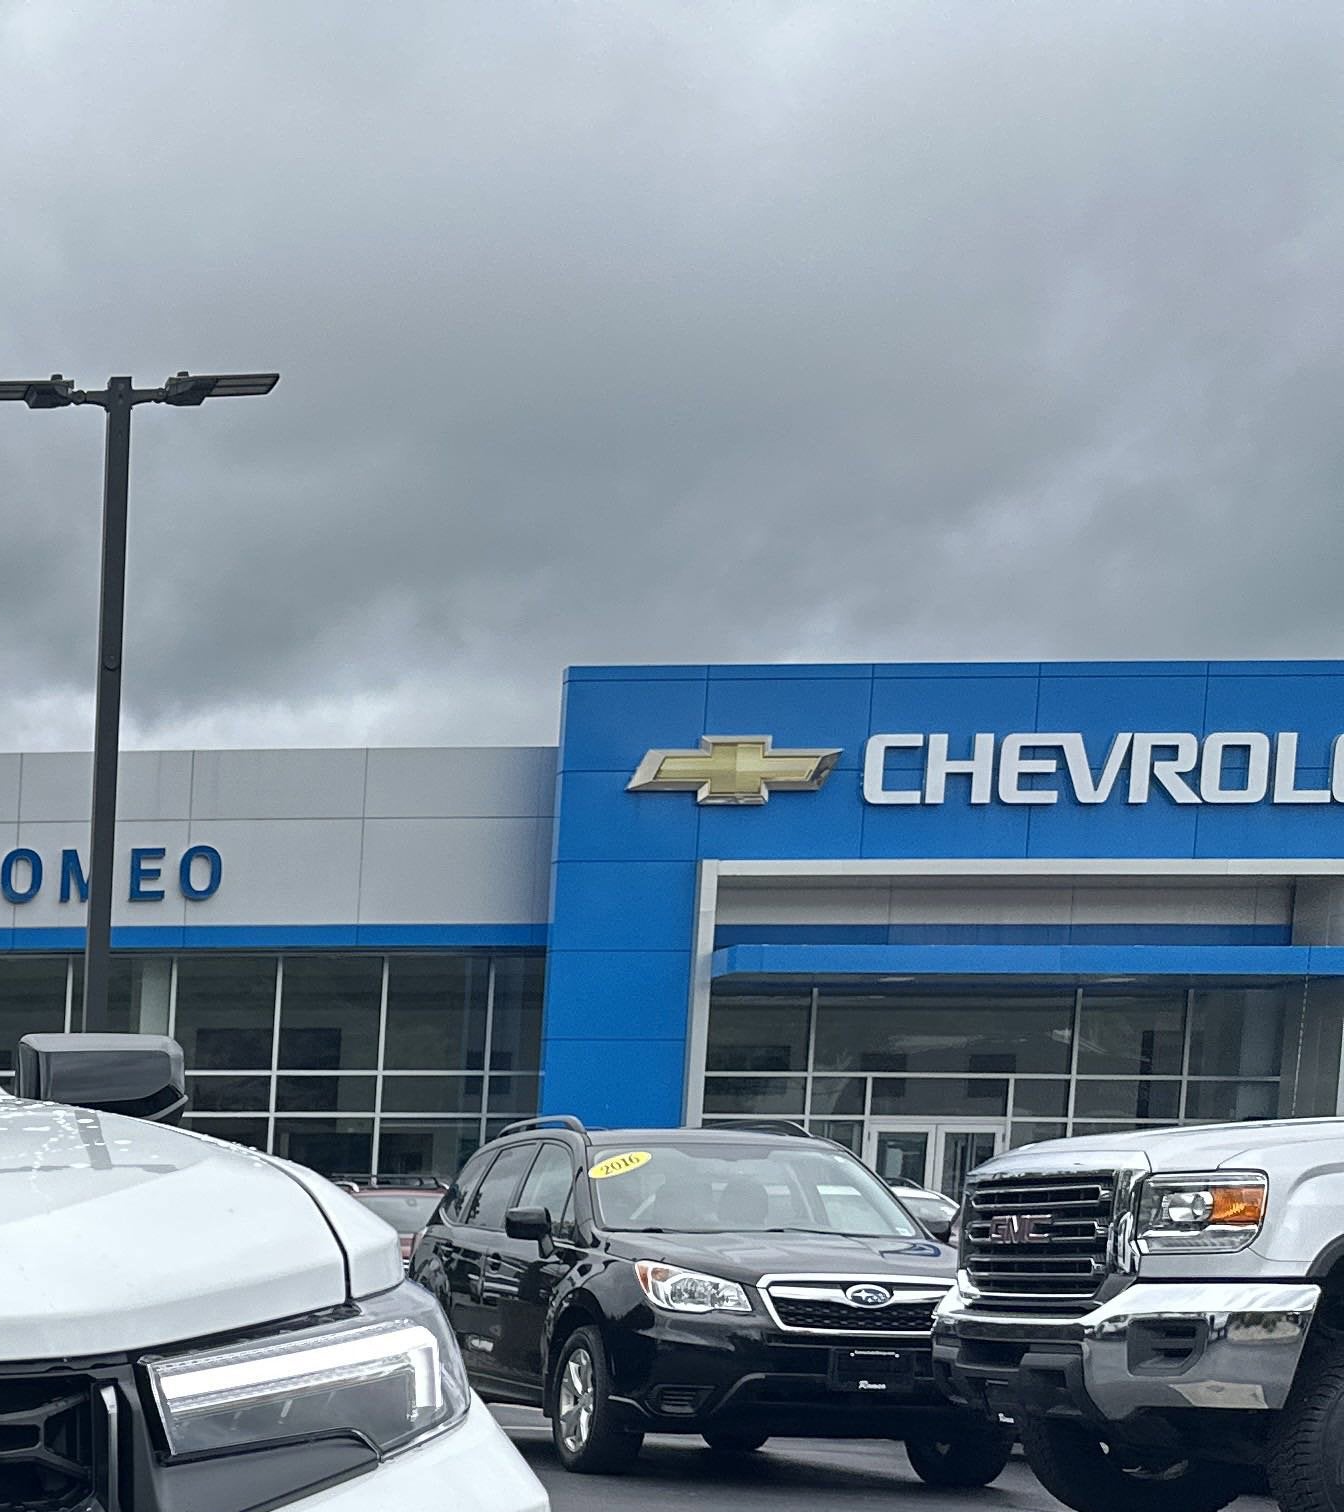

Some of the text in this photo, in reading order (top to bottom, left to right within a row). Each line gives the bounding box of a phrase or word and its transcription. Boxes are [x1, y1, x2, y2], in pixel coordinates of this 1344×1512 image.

[862, 731, 1344, 804] CHEVROL
[600, 1154, 640, 1176] 2016
[990, 1214, 1052, 1244] GMC
